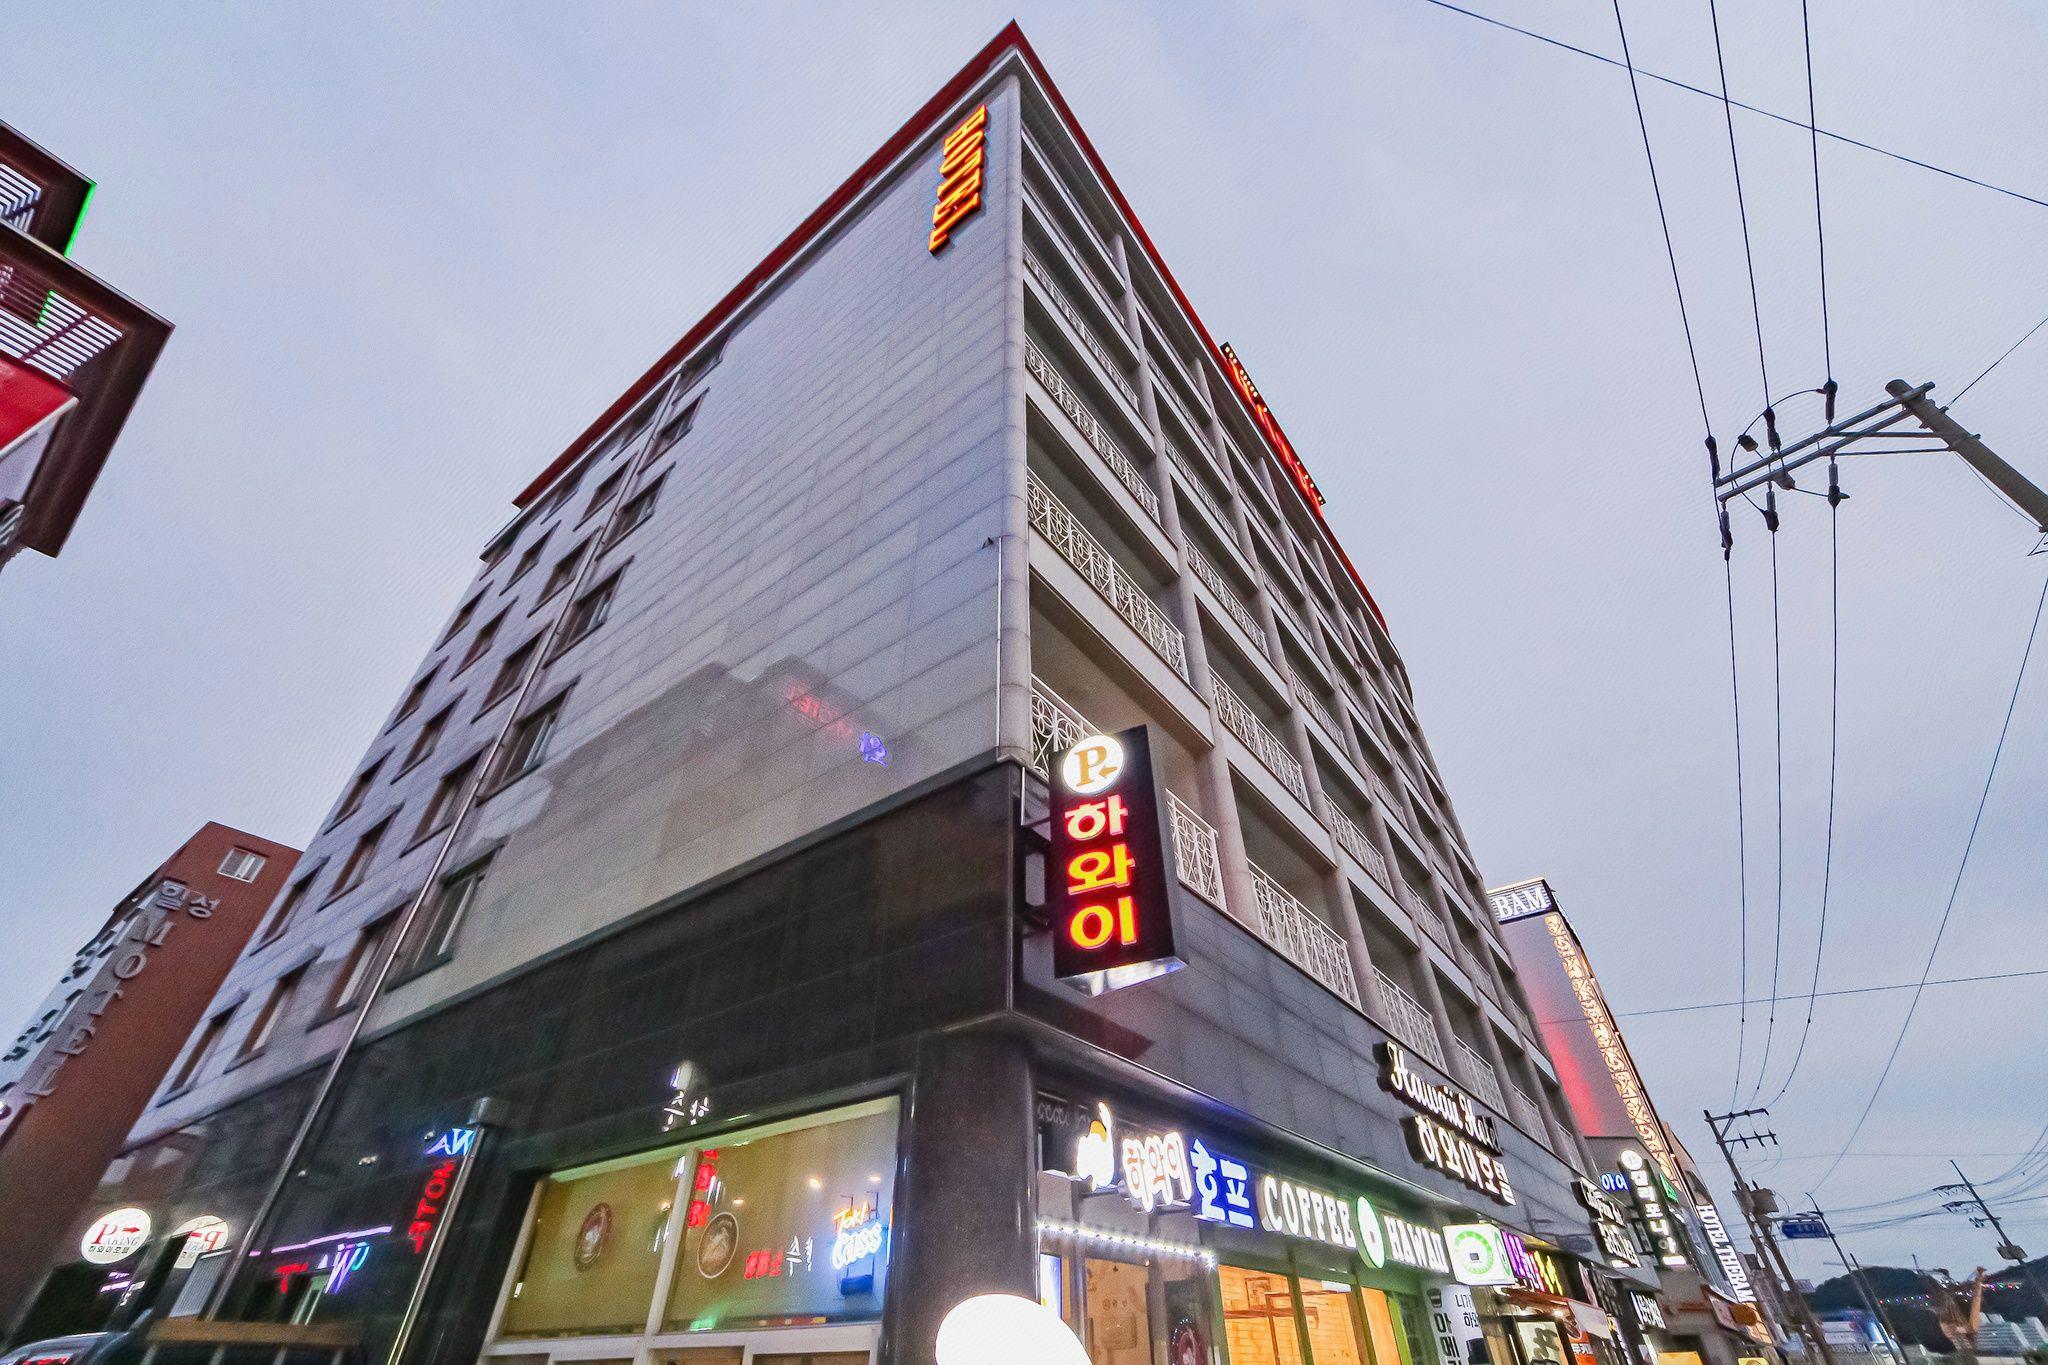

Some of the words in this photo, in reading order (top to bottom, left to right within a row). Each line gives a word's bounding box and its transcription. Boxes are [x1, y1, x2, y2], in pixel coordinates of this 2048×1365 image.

[928, 104, 987, 253] HOTEL
[1064, 794, 1137, 950] 하와이
[1386, 1040, 1464, 1130] Hawaii
[1414, 1114, 1517, 1206] 하와이호텔
[1263, 1175, 1357, 1249] COFFEE
